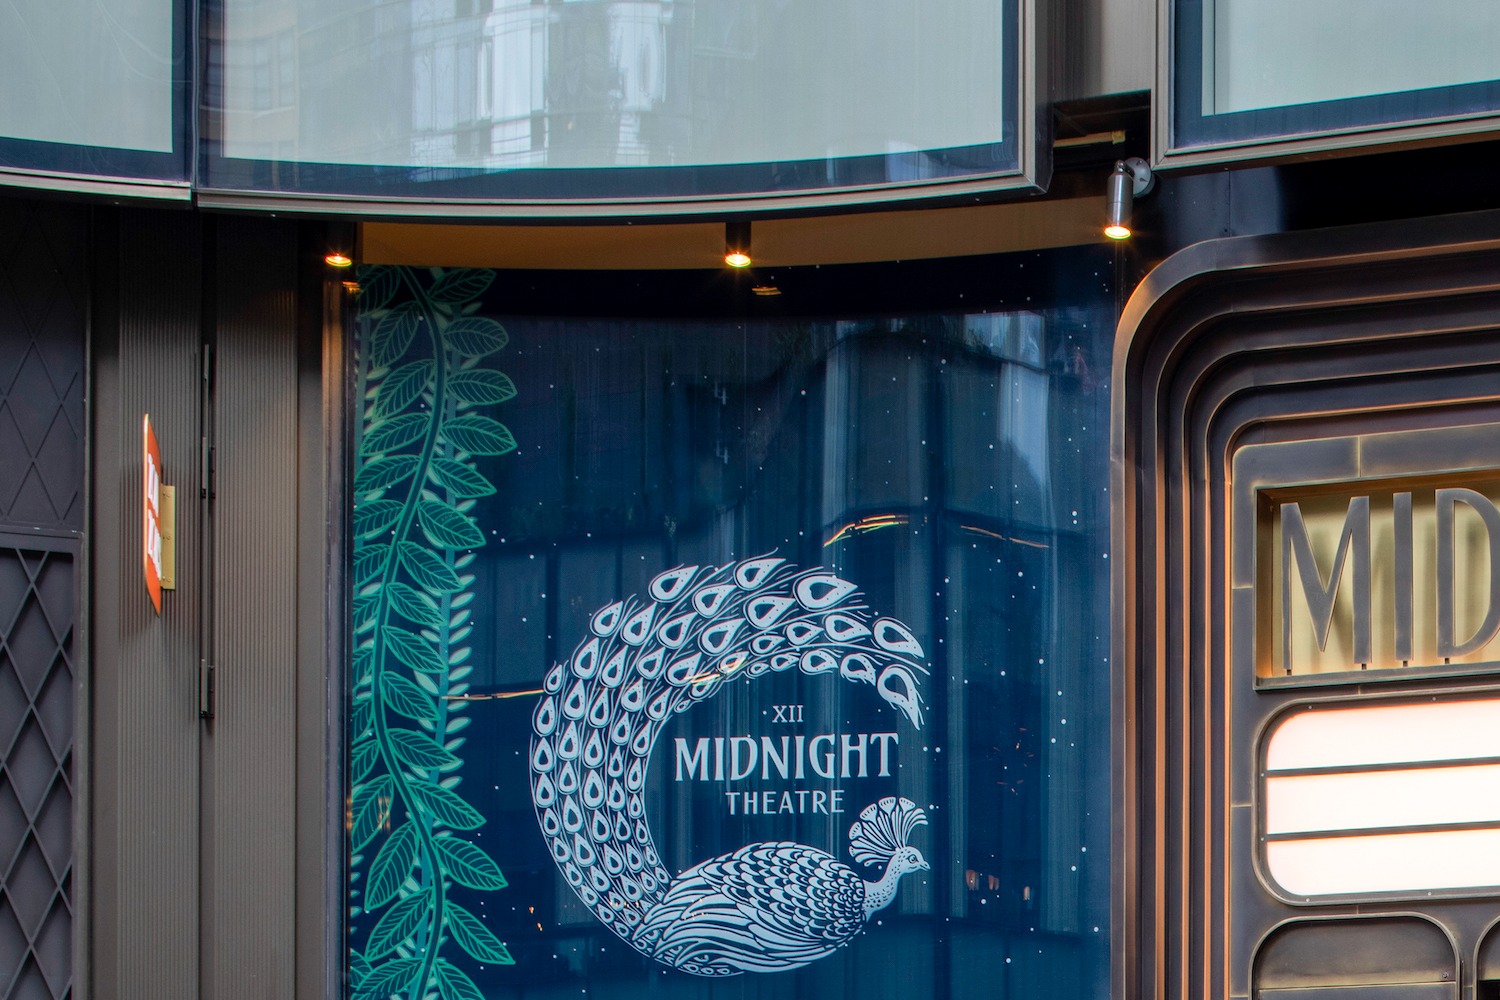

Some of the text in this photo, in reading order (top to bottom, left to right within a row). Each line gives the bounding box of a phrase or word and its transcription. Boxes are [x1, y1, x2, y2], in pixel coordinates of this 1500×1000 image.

[772, 705, 804, 724] XII
[674, 733, 899, 782] MIDNIGHT
[725, 790, 846, 816] THEATRE
